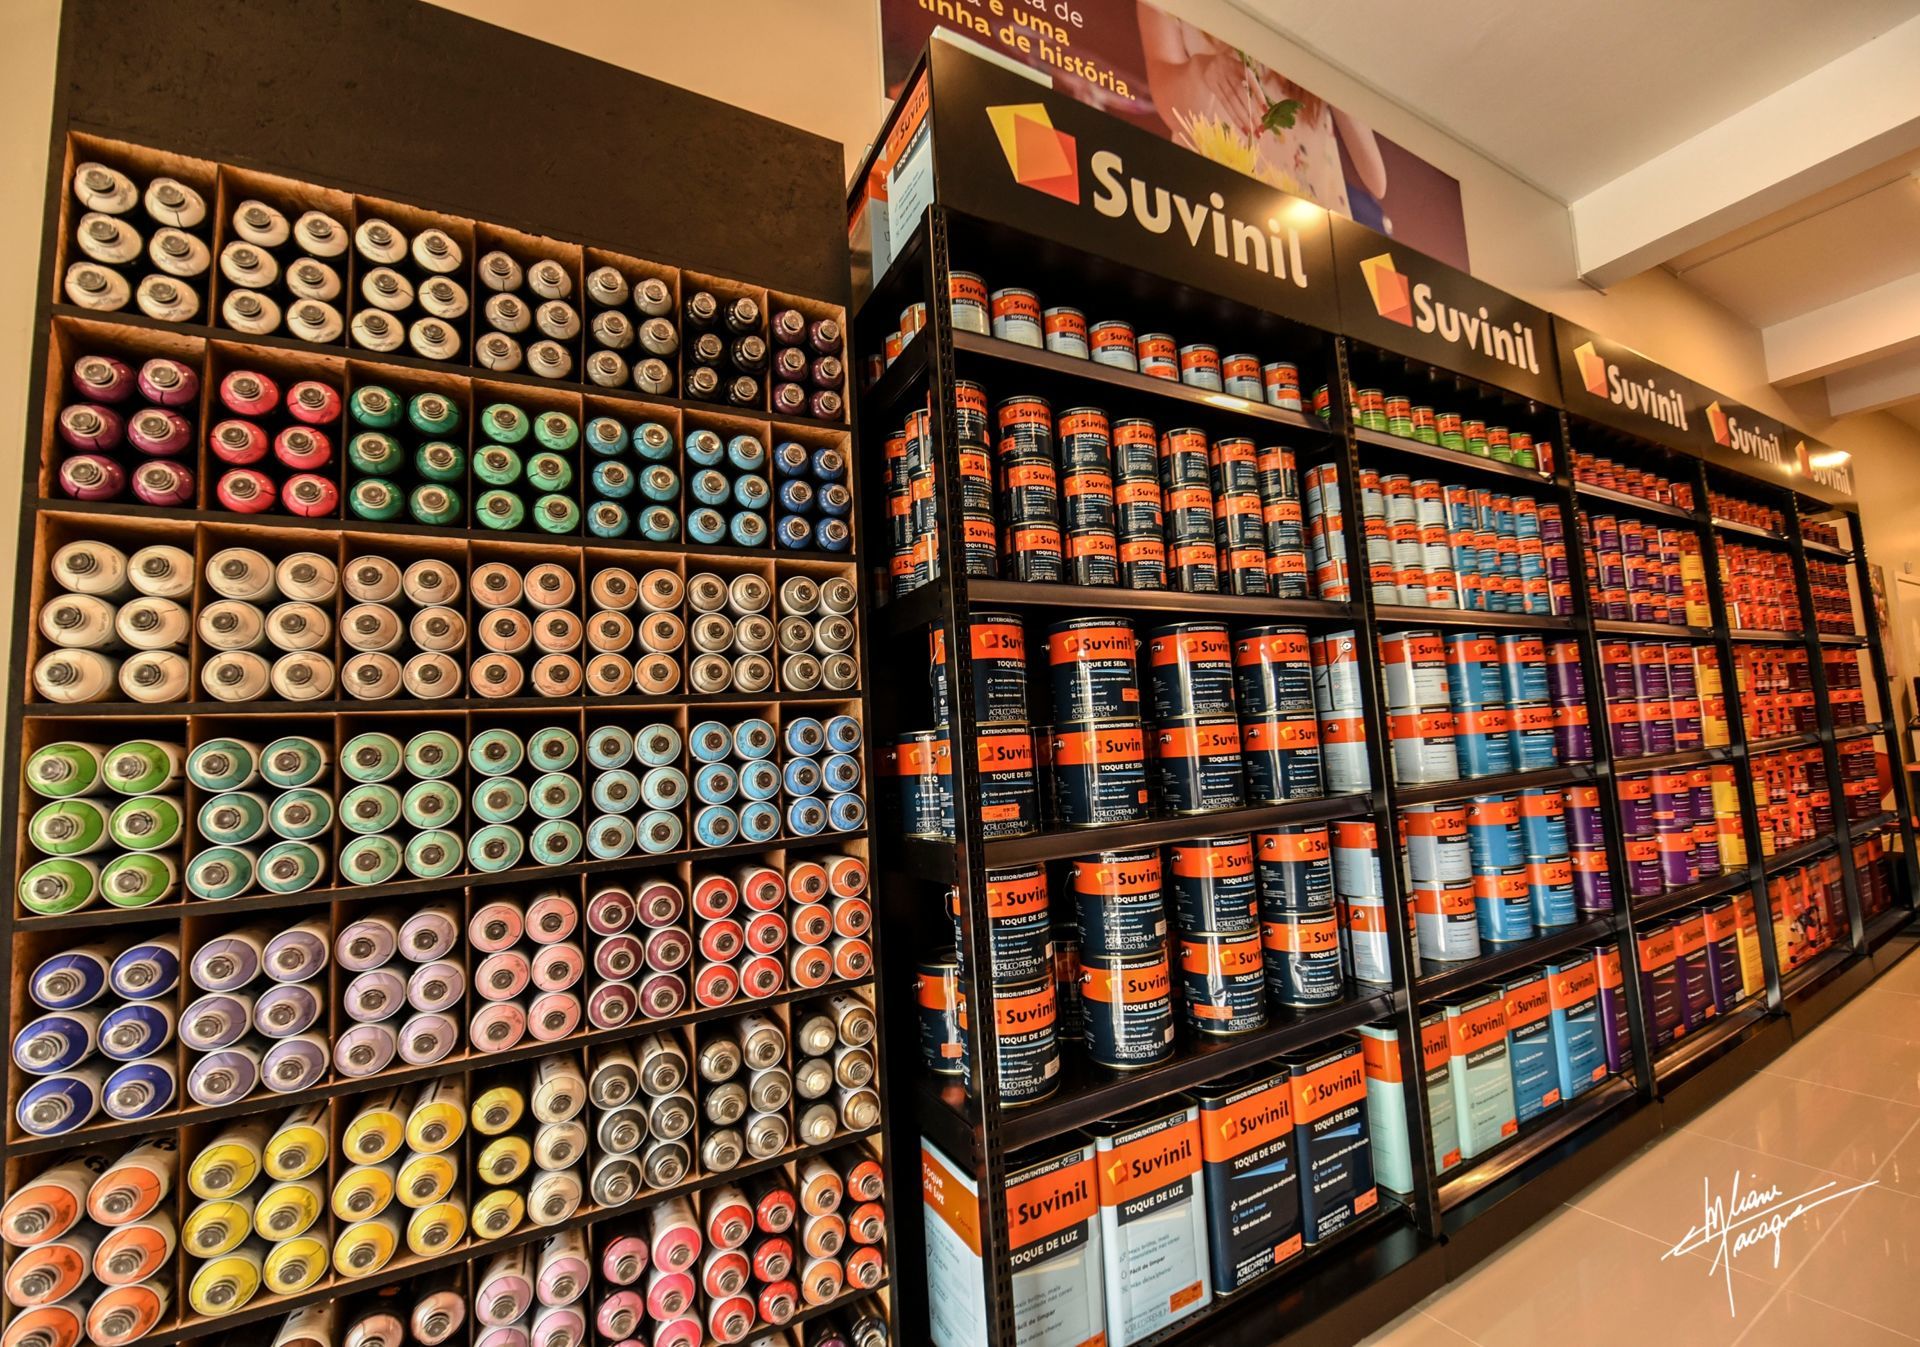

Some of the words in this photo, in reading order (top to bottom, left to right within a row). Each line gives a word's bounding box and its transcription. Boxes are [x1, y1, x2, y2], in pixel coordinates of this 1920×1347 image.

[1013, 6, 1070, 46] uma
[1054, 2, 1083, 28] de
[999, 25, 1031, 54] de
[1039, 39, 1136, 101] história.
[1090, 149, 1308, 289] Suvinil
[1412, 282, 1540, 375] Suvinil
[1606, 363, 1688, 432] Suvinil
[1727, 416, 1782, 466] Suvinil
[1113, 896, 1137, 904] TOQUE
[1001, 917, 1027, 926] TOQUE
[1029, 914, 1037, 922] DE
[1570, 973, 1594, 993] Suvinil
[1124, 1004, 1148, 1012] TOQUE
[1518, 991, 1548, 1014] Suvinil
[1000, 1036, 1027, 1044] TOQUE
[1029, 1033, 1038, 1041] DE
[1471, 1013, 1505, 1037] Suvinil
[1319, 1069, 1361, 1100] Suvinil
[1241, 1100, 1289, 1135] Suvinil
[1314, 1116, 1334, 1132] TOQUE
[1335, 1113, 1343, 1123] DE
[1344, 1107, 1359, 1120] SEDA
[1132, 1139, 1192, 1178] Suvinil
[1234, 1154, 1258, 1170] TOQUE
[1259, 1149, 1268, 1159] DE
[1270, 1140, 1286, 1155] SEDA
[922, 1163, 943, 1188] Toque
[923, 1179, 933, 1193] de
[1018, 1179, 1088, 1225] Suvinil
[1125, 1197, 1155, 1215] TOQUE
[1156, 1192, 1167, 1203] DE
[1169, 1184, 1183, 1198] LUZ
[1010, 1244, 1044, 1267] TOQUE
[1046, 1237, 1059, 1251] DE
[1061, 1229, 1078, 1245] LUZ
